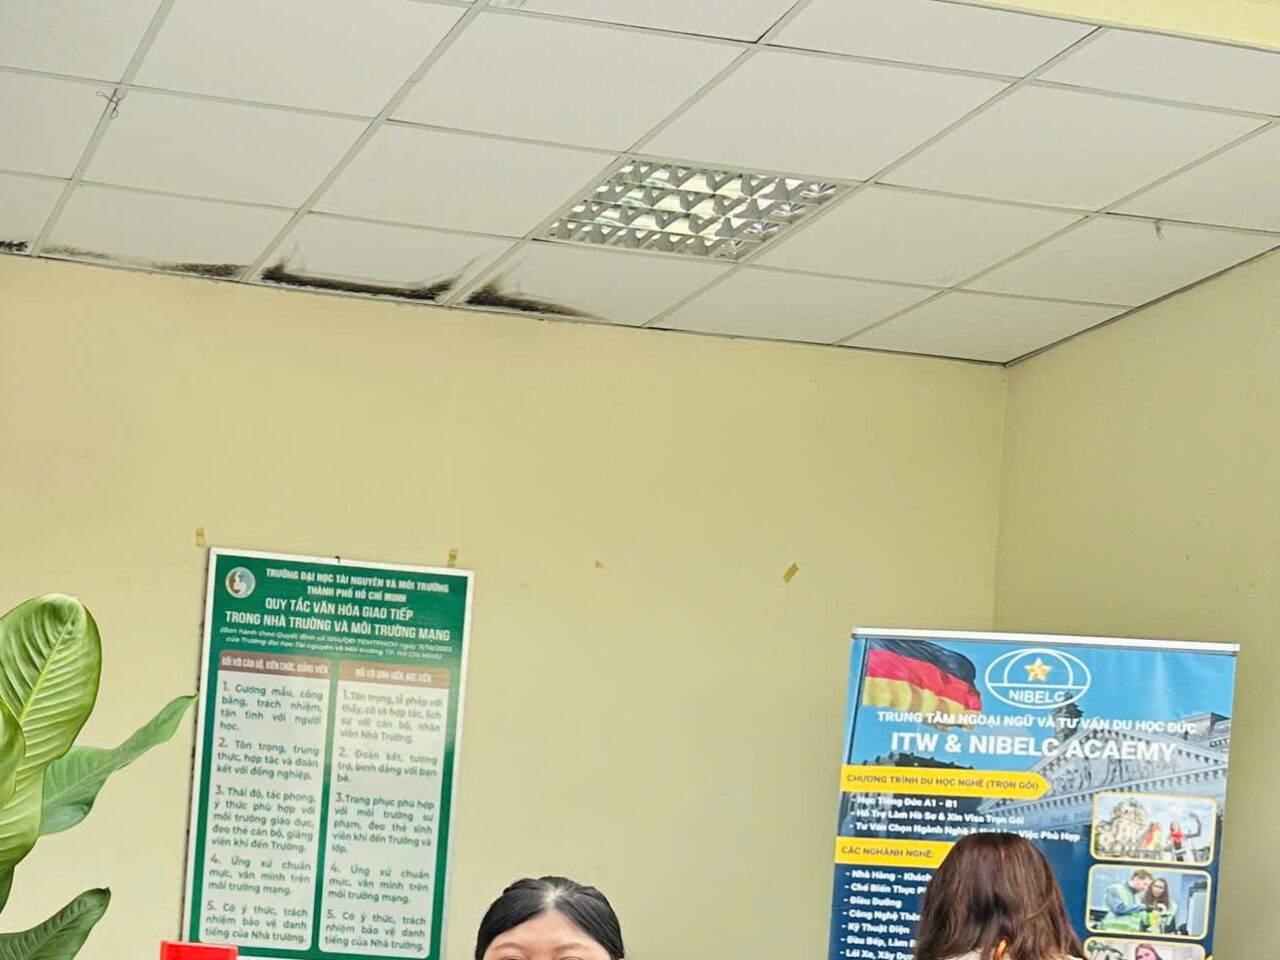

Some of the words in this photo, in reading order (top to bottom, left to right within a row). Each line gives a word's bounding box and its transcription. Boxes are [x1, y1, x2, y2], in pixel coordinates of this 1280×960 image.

[265, 597, 287, 610] QUY
[289, 595, 310, 612] TẮC
[312, 600, 335, 614] VĂN
[337, 601, 360, 616] HÓA
[362, 605, 387, 619] GIAO
[390, 605, 413, 621] TIẾP
[224, 610, 260, 624] TRONG
[263, 612, 286, 627] NHÀ
[288, 613, 331, 631] TRƯỜNG
[333, 618, 348, 632] VÀ
[351, 619, 371, 634] MÔI
[373, 621, 416, 638] TRƯỜNG
[418, 627, 450, 643] MẠNG
[1008, 689, 1064, 704] NIBELC
[876, 711, 921, 723] TRUNG
[925, 710, 956, 724] TÂM
[959, 714, 1000, 727] NGOẠI
[1004, 713, 1033, 727] NGỮ
[1036, 716, 1054, 727] VÀ
[1057, 717, 1078, 728] TƯ
[1080, 716, 1109, 730] VẤN
[1114, 720, 1133, 730] DU
[1136, 720, 1164, 733] HỌC
[1167, 719, 1196, 733] ĐỨC
[891, 731, 938, 752] ITW
[945, 735, 962, 752] &
[969, 734, 1059, 756] NIBELC
[1065, 738, 1176, 761] ACAEMY
[846, 773, 887, 783] CHƯƠNG
[889, 773, 917, 784] TRÌNH
[920, 777, 933, 785] DU
[935, 778, 954, 787] HỌC
[986, 780, 1015, 790] (TRỌN
[1018, 779, 1038, 790] GÓI)
